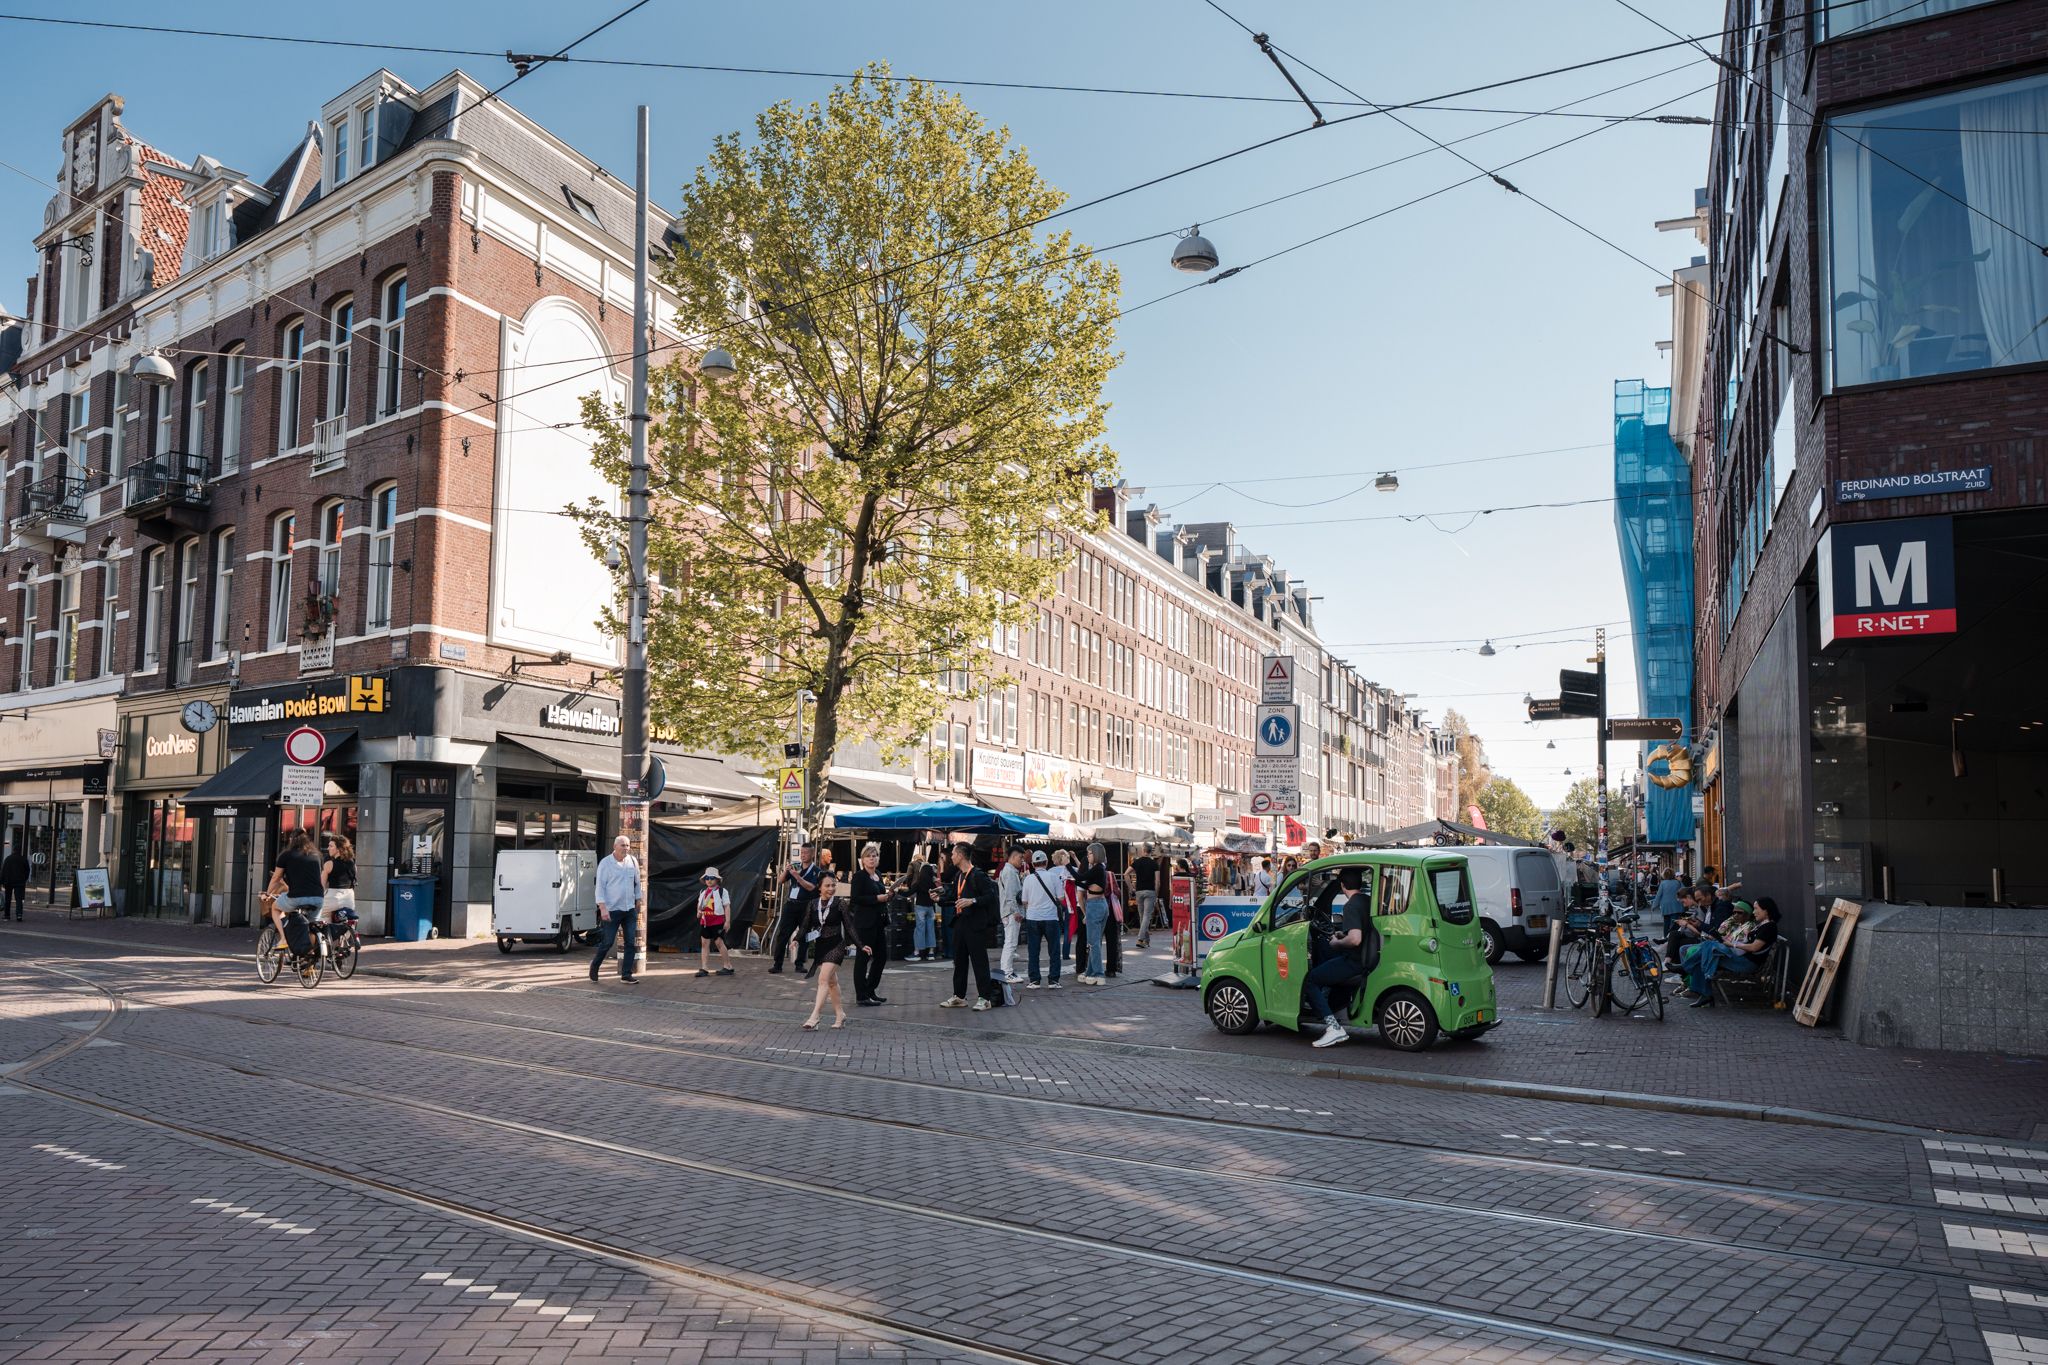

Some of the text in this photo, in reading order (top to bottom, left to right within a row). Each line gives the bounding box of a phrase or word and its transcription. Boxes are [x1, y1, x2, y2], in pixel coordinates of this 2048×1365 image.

[1841, 468, 1985, 492] FERDINAND BOLSTRAAT
[1965, 480, 1986, 489] ZUID
[1853, 492, 1866, 501] Pijp
[1854, 540, 1929, 608] M
[318, 695, 346, 715] Bow
[1231, 910, 1255, 918] Verbod
